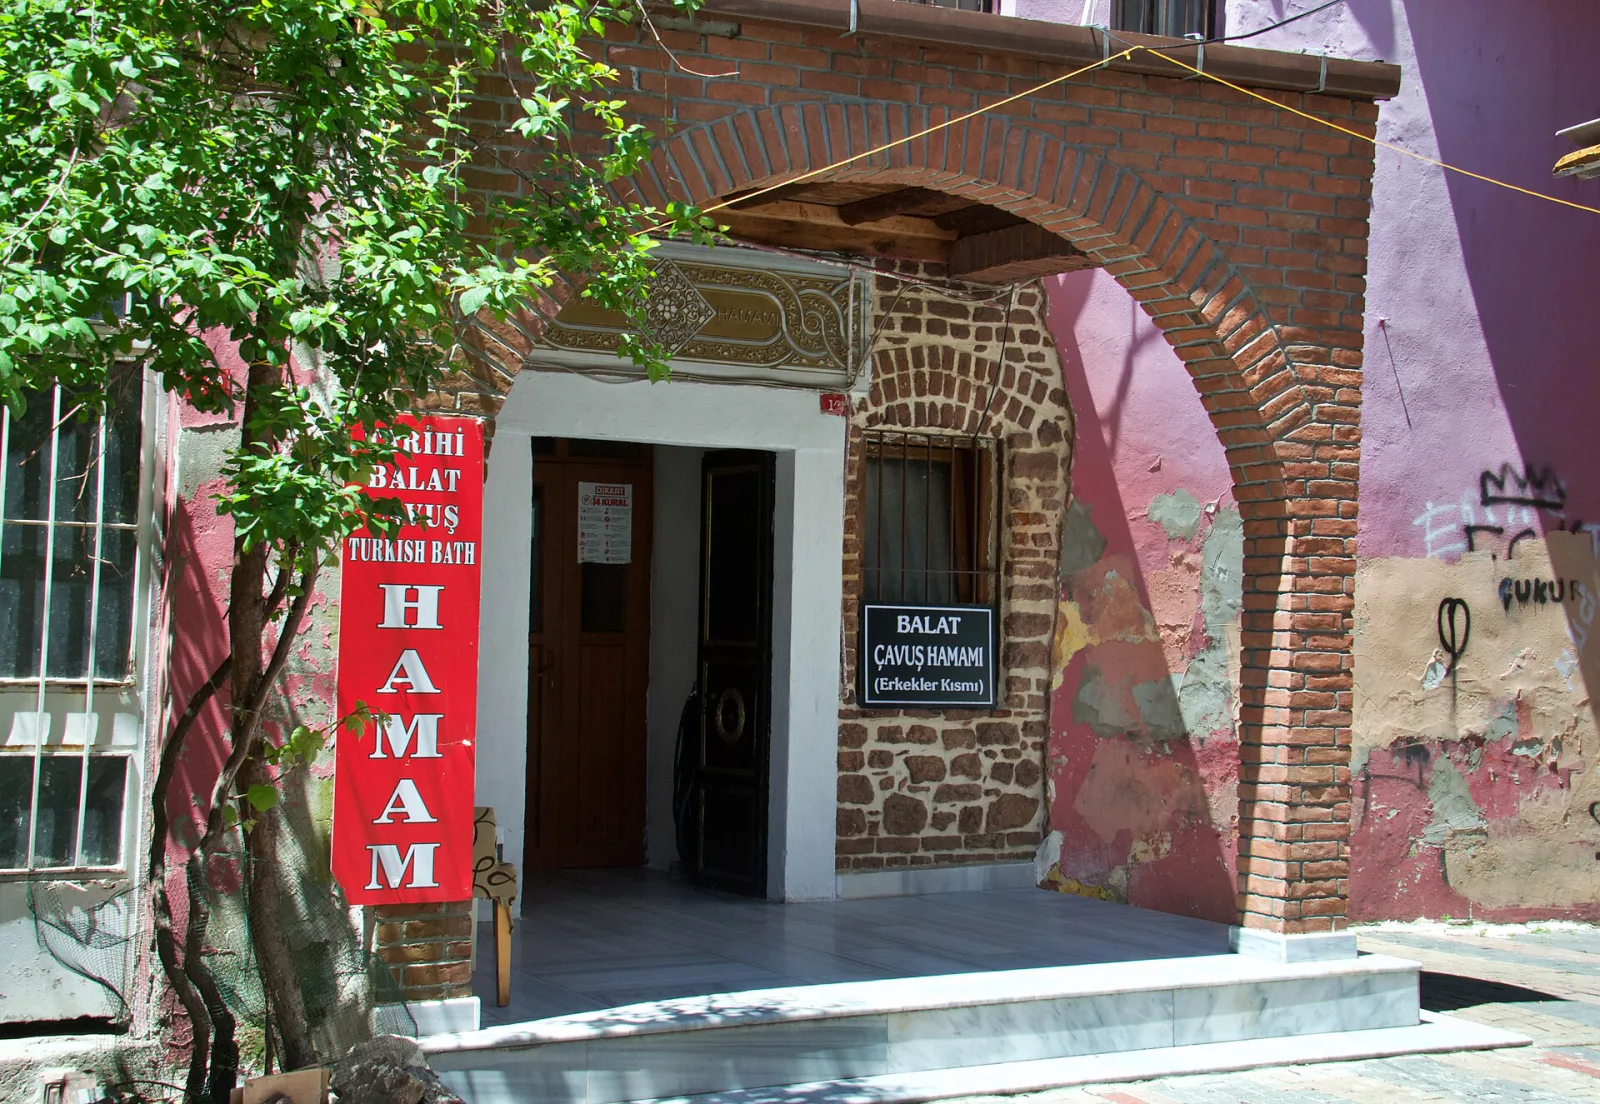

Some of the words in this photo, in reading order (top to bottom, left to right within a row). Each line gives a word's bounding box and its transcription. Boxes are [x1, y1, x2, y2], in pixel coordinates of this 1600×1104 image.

[716, 306, 779, 326] HAMAMI
[367, 464, 461, 492] BALAT
[602, 498, 628, 507] KURAL
[373, 502, 459, 534] VUŞ
[348, 537, 426, 563] TURKISH
[430, 540, 476, 565] BATH
[897, 615, 961, 634] BALAT
[874, 644, 924, 672] ÇAVUŞ
[927, 646, 983, 667] HAMAMI
[874, 677, 938, 694] (Erkekler
[941, 678, 984, 695] Kısmı)
[363, 583, 445, 891] HAMAM
